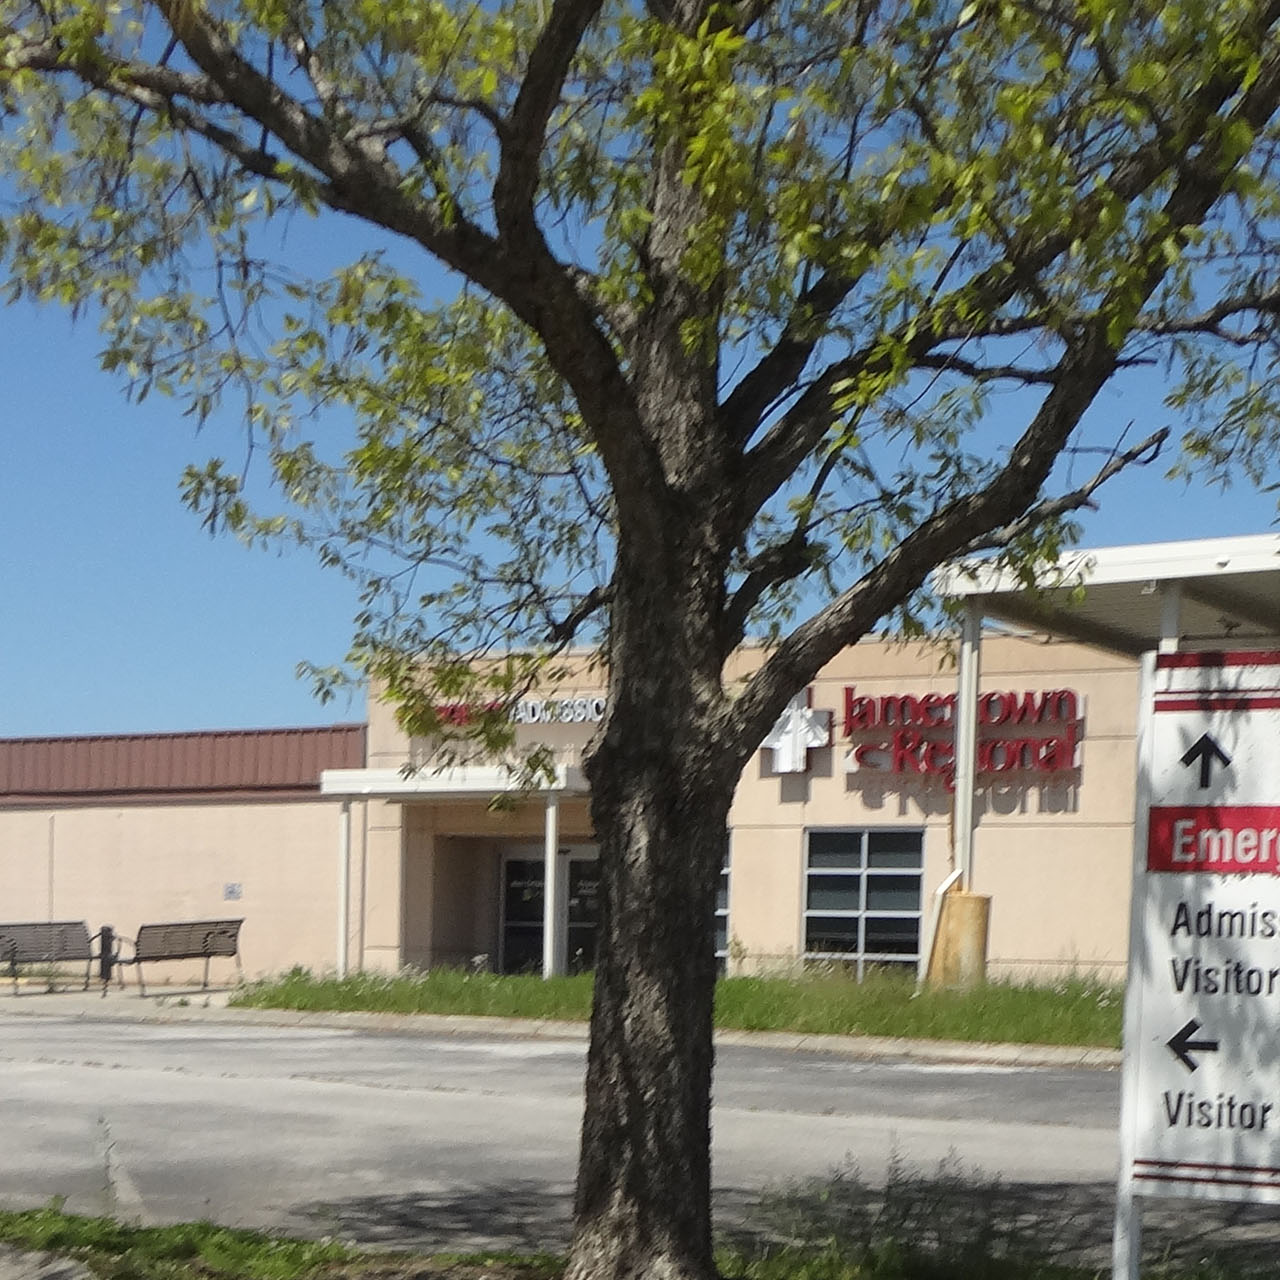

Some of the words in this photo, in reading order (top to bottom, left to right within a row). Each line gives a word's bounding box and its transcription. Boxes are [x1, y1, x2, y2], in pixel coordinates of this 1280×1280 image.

[842, 685, 1078, 737] Jameown
[1171, 957, 1280, 996] Visitor
[1164, 1091, 1271, 1131] Visitor
